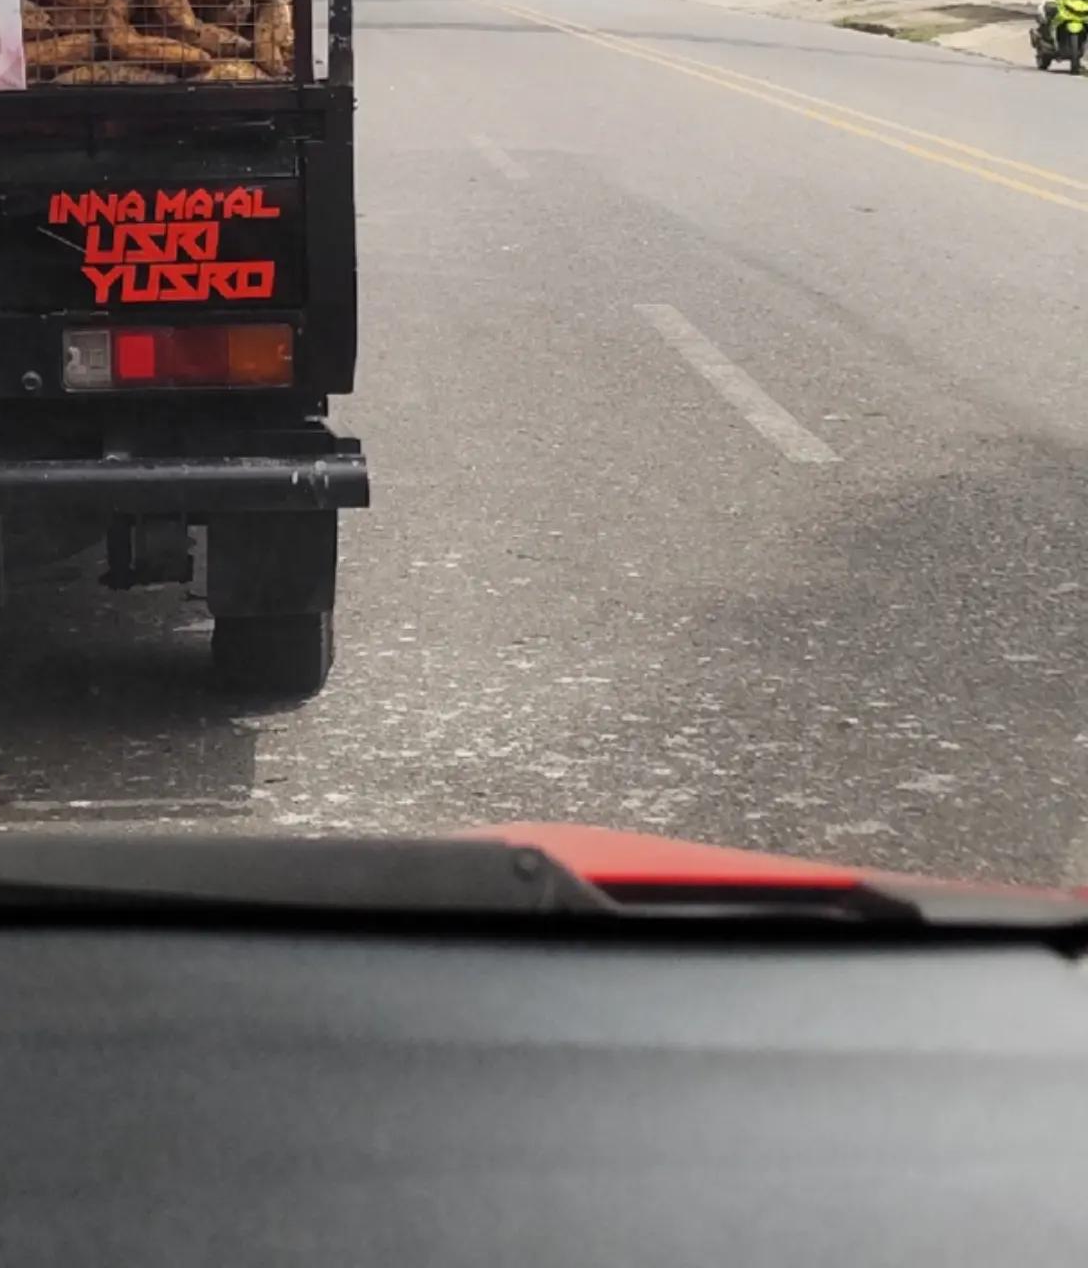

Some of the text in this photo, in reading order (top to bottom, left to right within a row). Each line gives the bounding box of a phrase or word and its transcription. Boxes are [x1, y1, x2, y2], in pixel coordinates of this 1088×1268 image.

[48, 189, 145, 226] INNA
[84, 221, 220, 263] USRI
[81, 260, 275, 304] YUSRO
